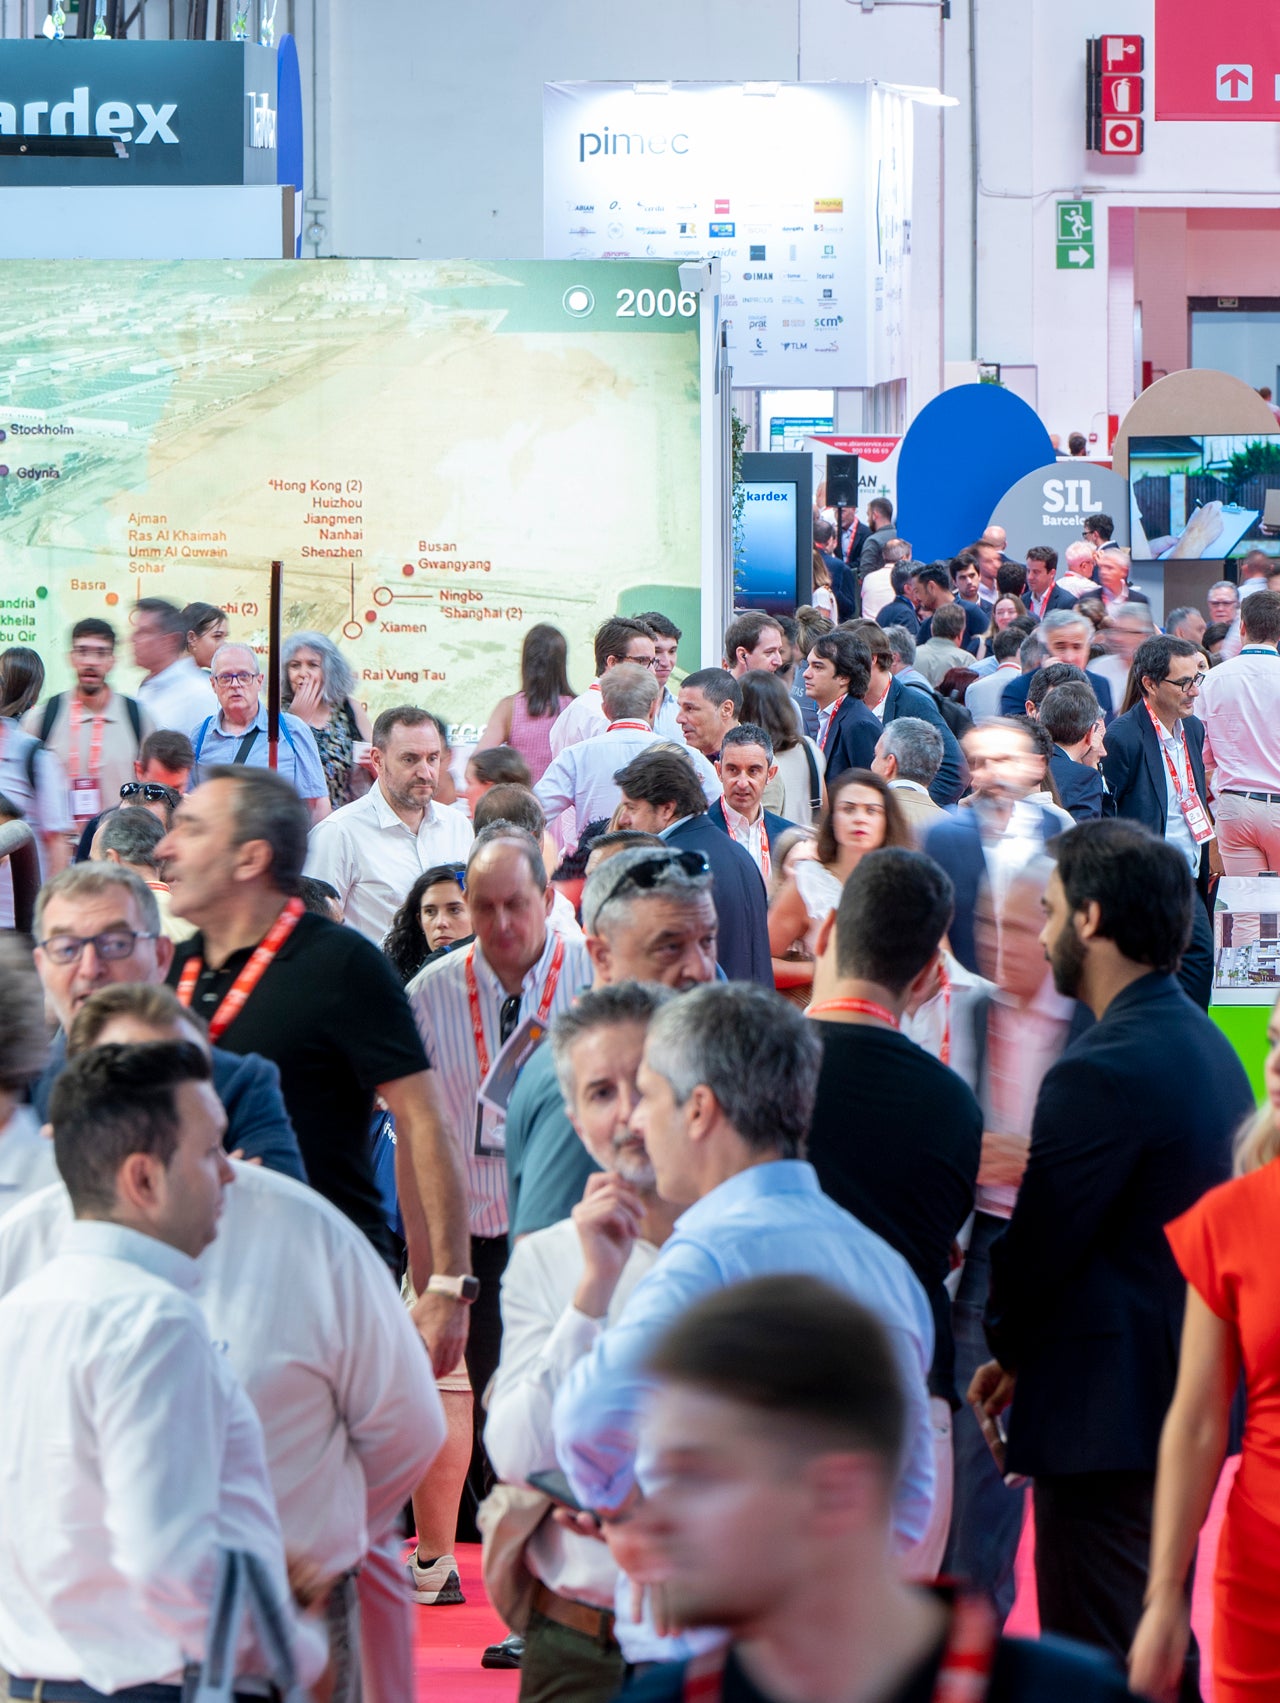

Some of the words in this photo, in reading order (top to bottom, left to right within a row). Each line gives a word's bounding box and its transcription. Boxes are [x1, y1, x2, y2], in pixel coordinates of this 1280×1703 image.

[580, 126, 689, 163] pimec
[616, 288, 697, 318] 2006
[791, 342, 808, 350] TLM
[10, 423, 75, 435] Stockholm
[17, 466, 60, 480] Gdynia
[310, 480, 342, 493] Kong
[346, 480, 363, 493] (2)
[746, 491, 788, 501] kardex
[1042, 479, 1103, 512] SIL
[312, 497, 363, 508] Huizhou
[128, 512, 168, 526] Ajman
[303, 513, 363, 527] Jiangmen
[1042, 514, 1087, 526] Barcelo
[128, 530, 153, 541] Ras
[156, 530, 170, 541] Al
[172, 530, 227, 541] Khaimah
[319, 529, 363, 540] Nanhai
[128, 546, 162, 558] Umm
[164, 546, 178, 558] Al
[181, 546, 228, 558] Quwain
[301, 546, 363, 558] Shenzhen
[418, 540, 458, 552] Busan
[128, 561, 166, 573] Sohar
[418, 557, 492, 572] Gwangyang
[70, 579, 107, 591] Basra
[439, 590, 484, 604] Ningbo
[241, 602, 259, 616] (2)
[505, 607, 523, 621] (2)
[380, 622, 427, 633] Xiamen
[18, 630, 37, 642] Qir
[363, 668, 384, 680] Rai
[386, 668, 419, 683] Vung
[422, 668, 446, 680] Tau
